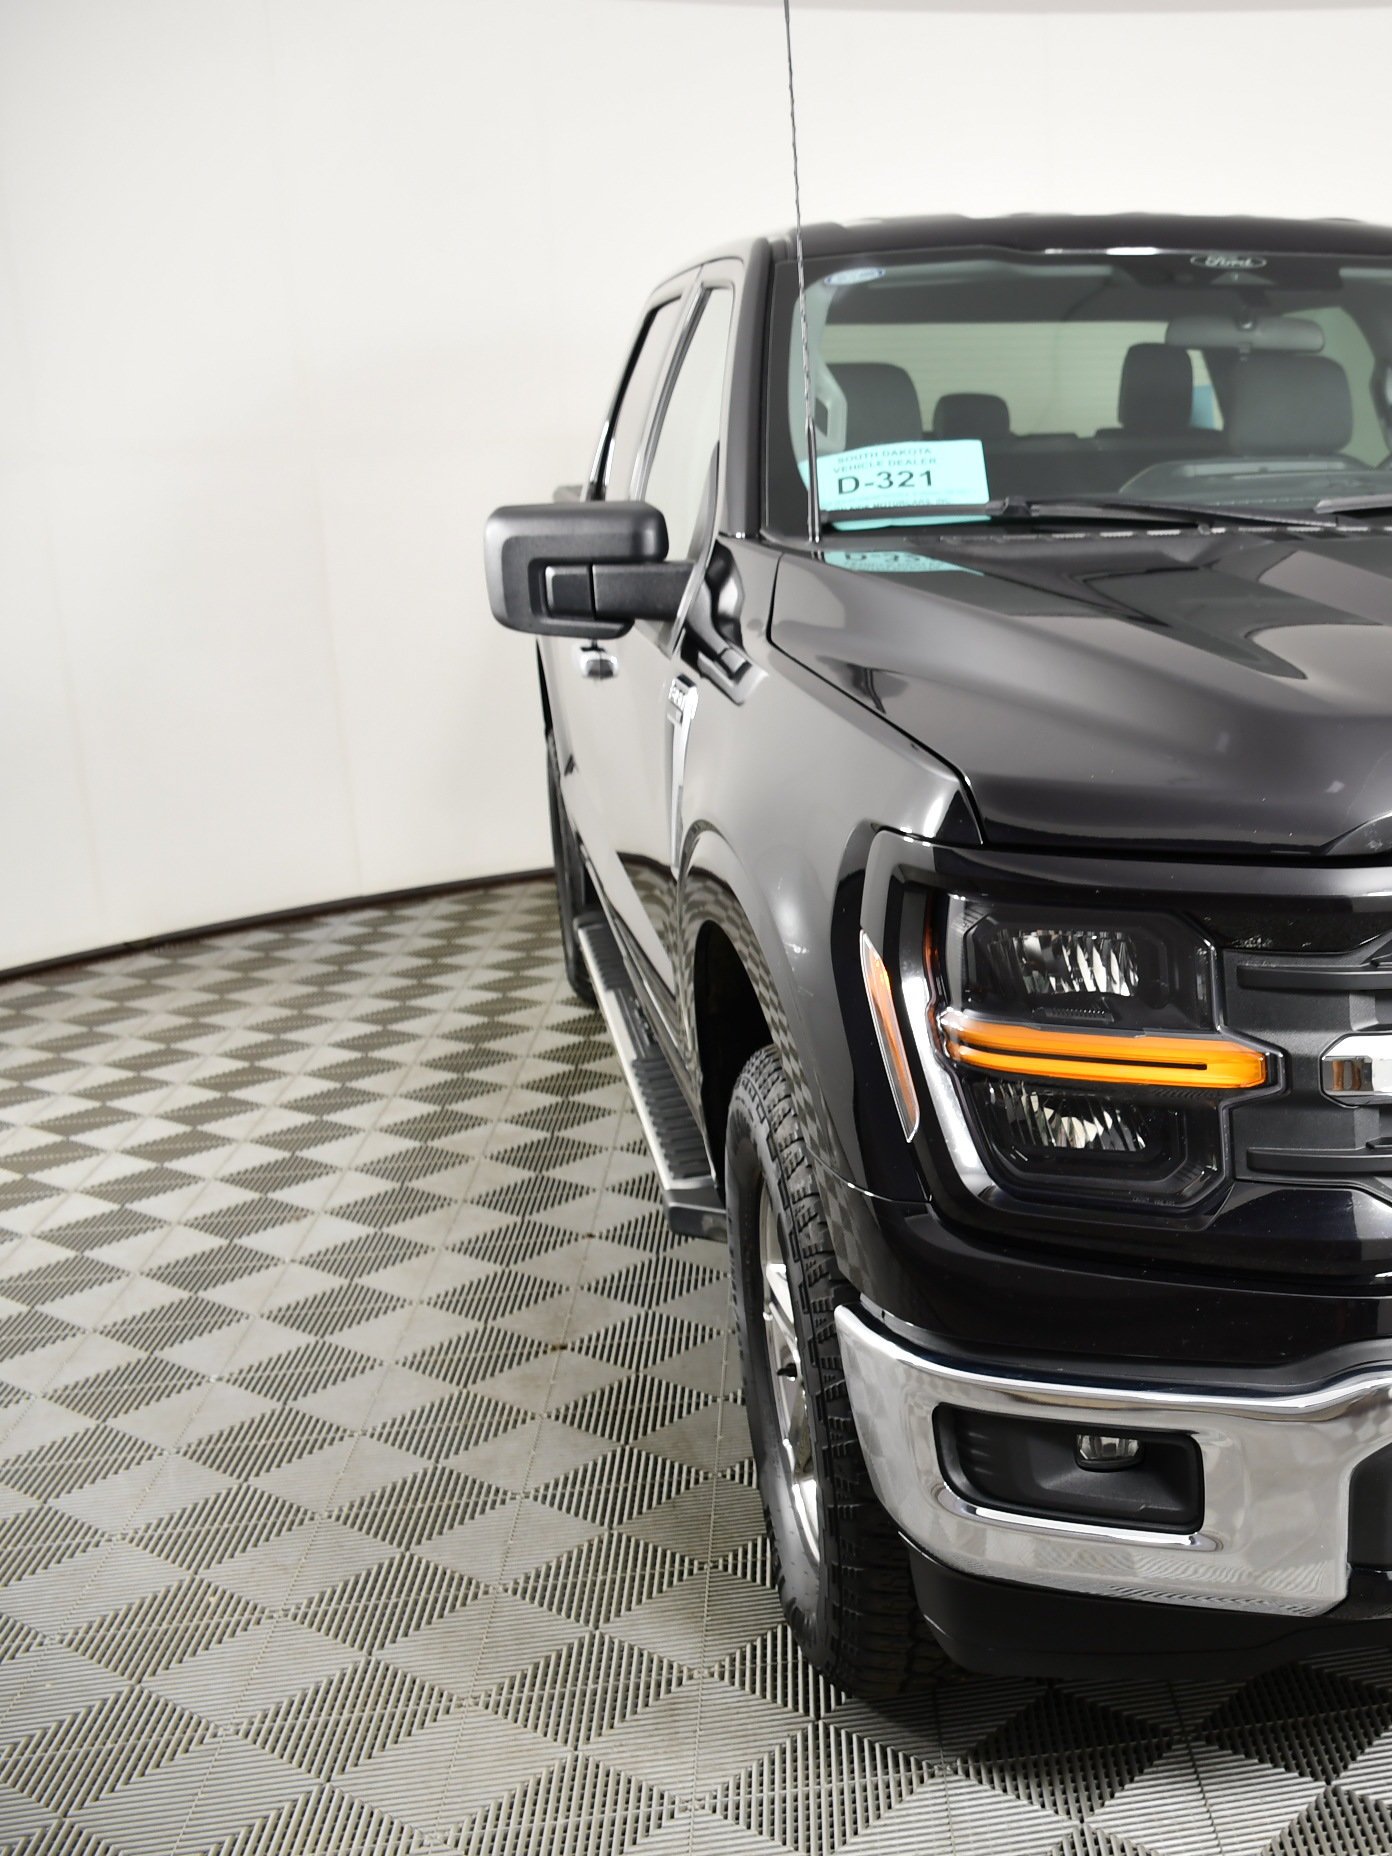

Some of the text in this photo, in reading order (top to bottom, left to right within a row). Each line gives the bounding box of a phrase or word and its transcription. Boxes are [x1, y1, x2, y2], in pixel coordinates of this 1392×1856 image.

[838, 448, 931, 463] SOUTH DAKOTA
[833, 457, 936, 473] VEHICLE DEALER
[837, 470, 933, 496] D-321
